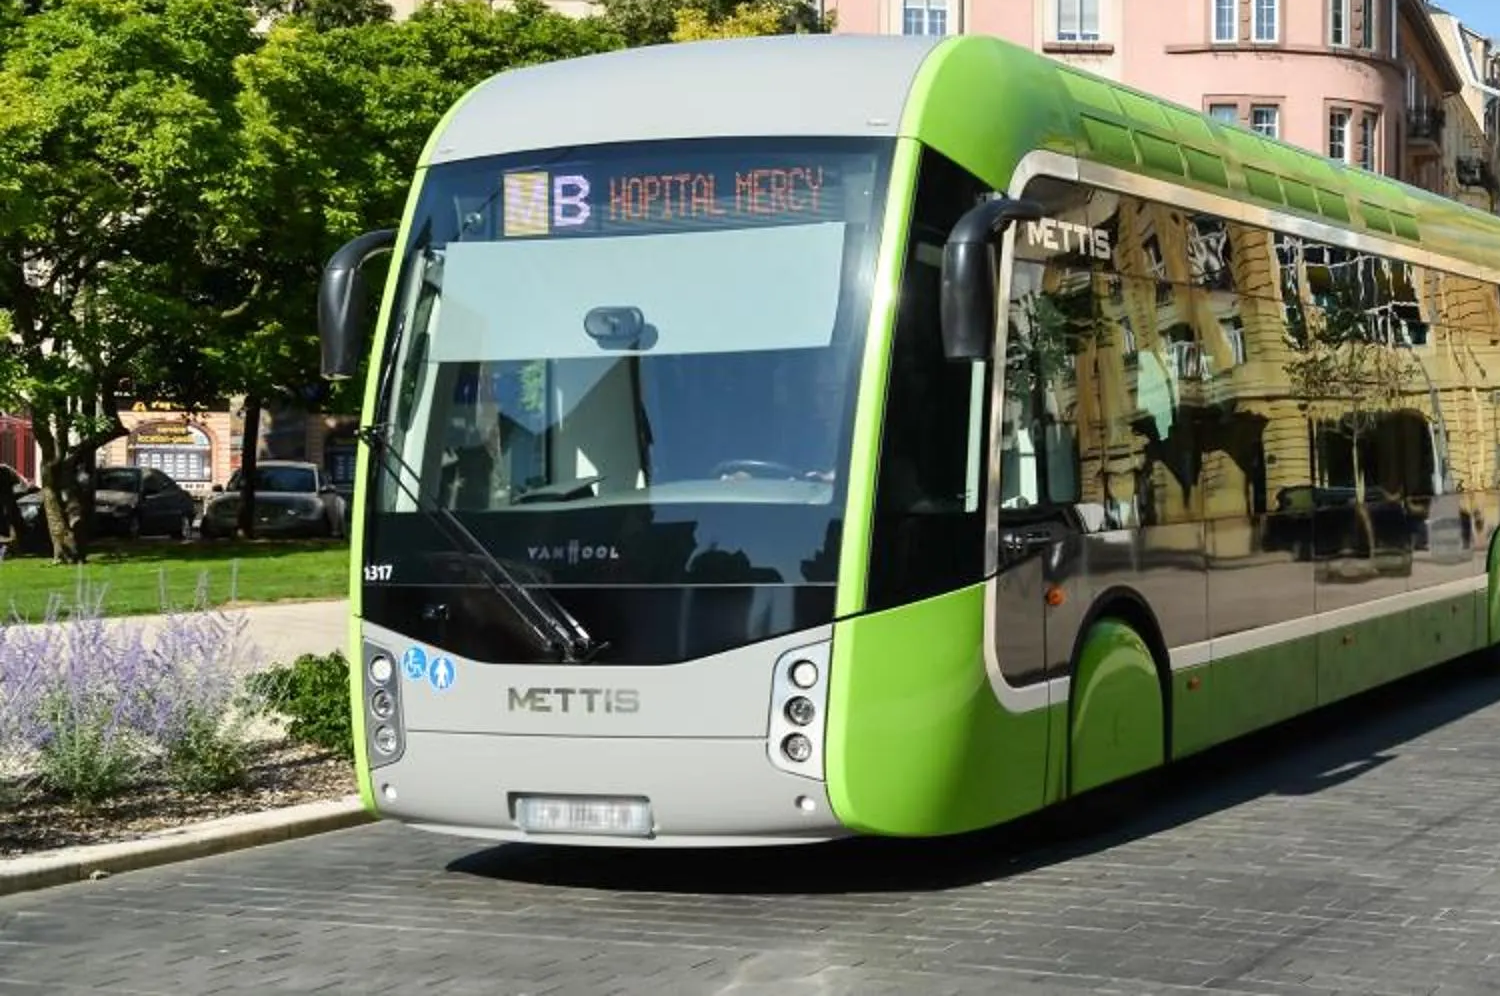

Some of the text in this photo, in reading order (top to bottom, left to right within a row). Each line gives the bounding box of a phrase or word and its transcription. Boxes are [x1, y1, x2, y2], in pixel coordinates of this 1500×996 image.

[553, 175, 591, 226] B
[735, 165, 823, 214] MERCY
[1027, 217, 1111, 260] METTIS
[364, 565, 393, 581] 1317
[508, 687, 640, 713] METTIS
